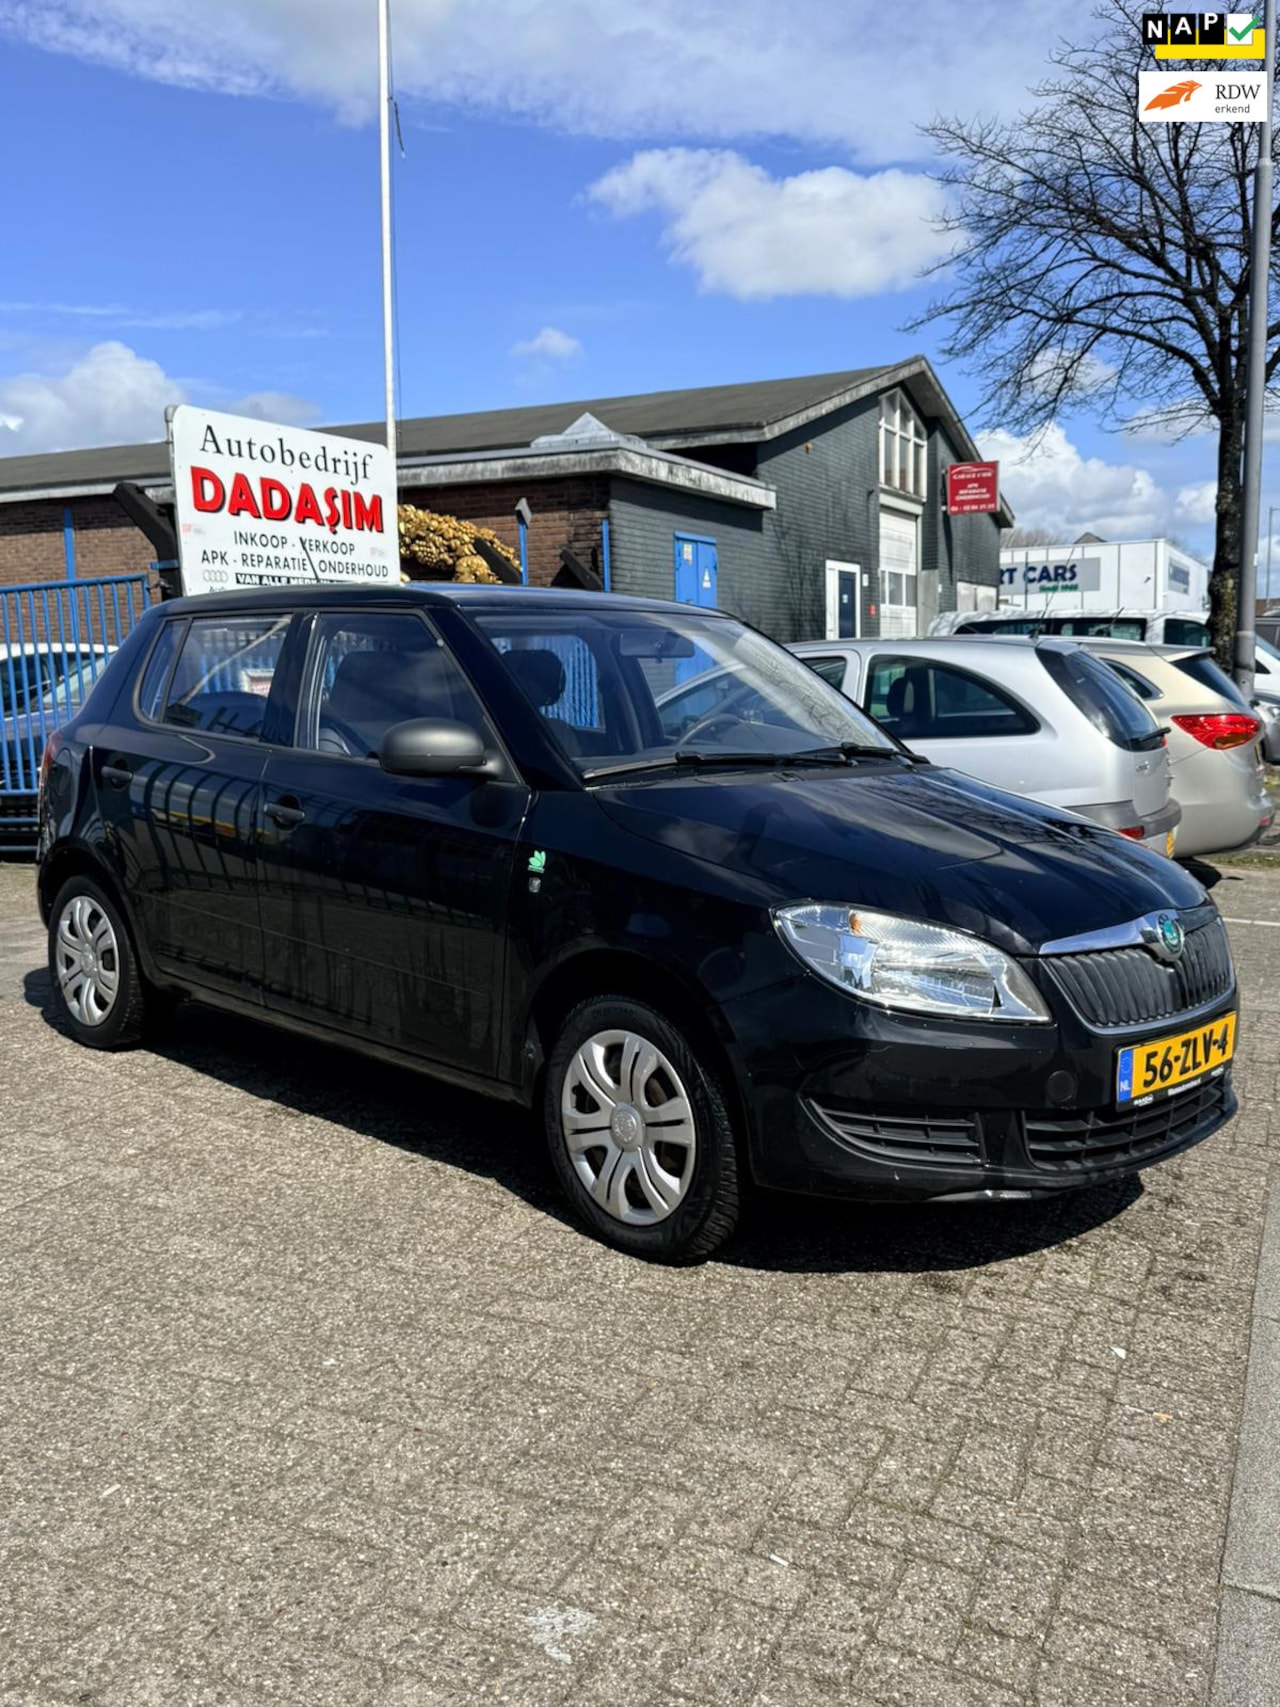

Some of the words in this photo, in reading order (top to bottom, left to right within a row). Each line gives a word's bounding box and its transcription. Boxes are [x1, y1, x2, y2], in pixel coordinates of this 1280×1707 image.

[200, 424, 373, 486] Autobedrijf
[190, 465, 384, 535] DADAŞIM
[234, 530, 288, 549] INKOOP
[301, 537, 355, 554] VERKOOP
[201, 549, 229, 565] APK
[241, 553, 308, 572] REPARATIE
[318, 559, 389, 577] ONDERHOUD
[1023, 564, 1077, 584] CARS
[237, 574, 260, 585] VAN
[261, 575, 287, 586] ALLE
[1142, 1023, 1229, 1088] 56-ZLV-4
[1120, 1080, 1130, 1091] NL
